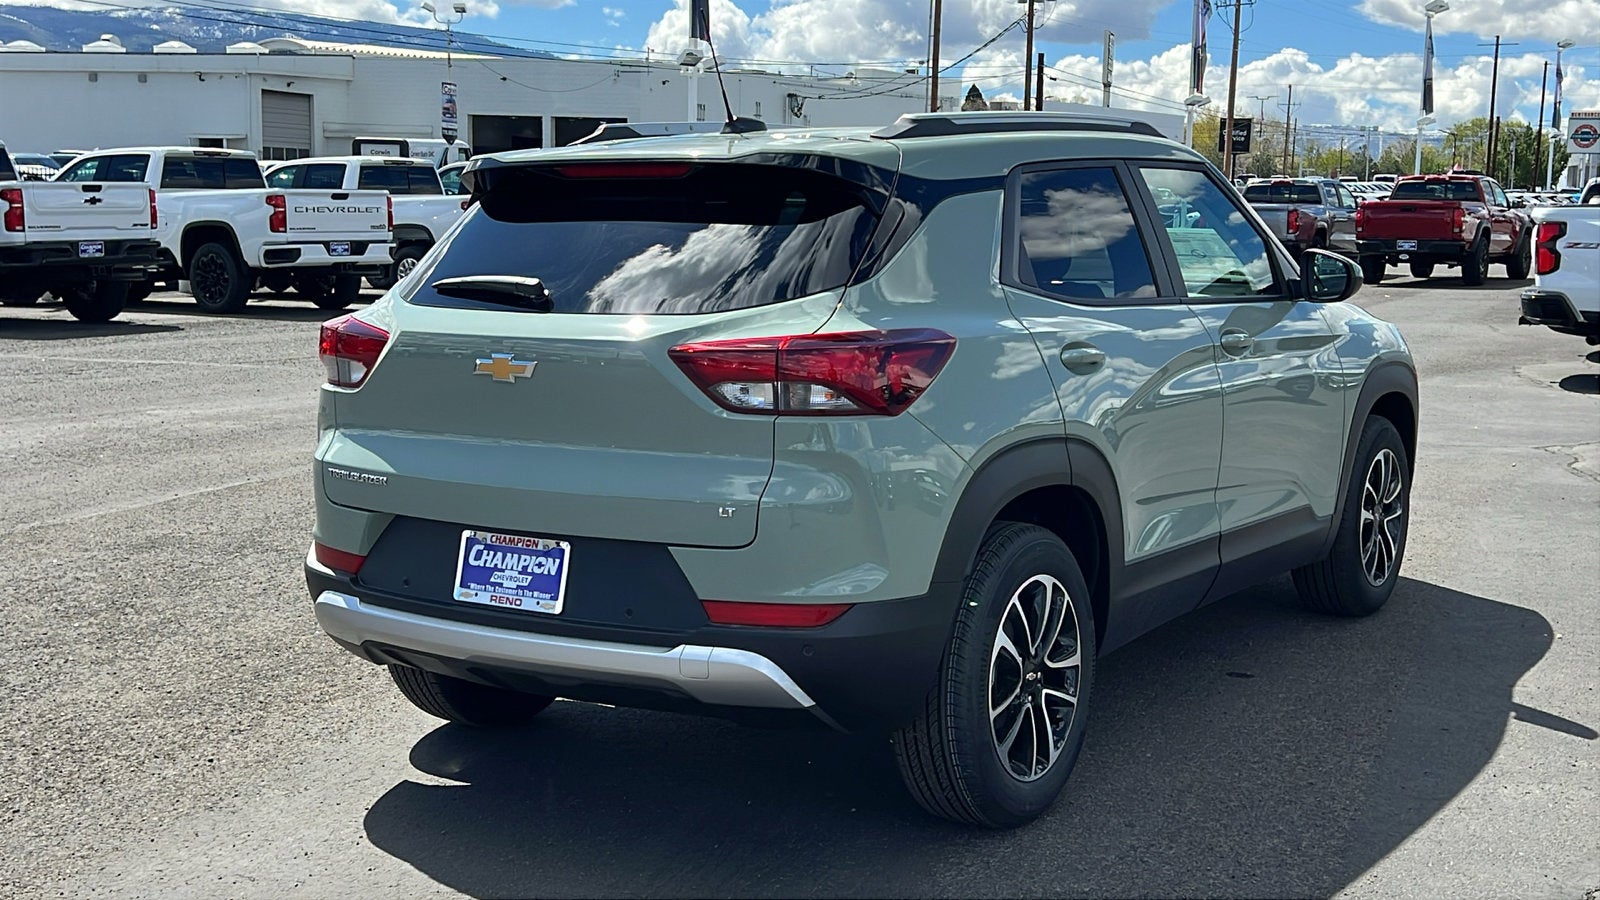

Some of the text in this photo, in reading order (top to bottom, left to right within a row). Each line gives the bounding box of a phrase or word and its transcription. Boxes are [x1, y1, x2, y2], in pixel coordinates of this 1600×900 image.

[370, 148, 391, 156] Corwin
[327, 467, 388, 486] TRAILBLAZER
[718, 506, 736, 518] LT
[490, 534, 540, 549] CHAMPION
[468, 544, 561, 576] CHAMPION
[493, 573, 530, 585] CHEVROLET
[486, 584, 495, 592] The
[495, 585, 517, 595] Customer
[524, 589, 533, 597] The
[489, 594, 524, 608] RENO
